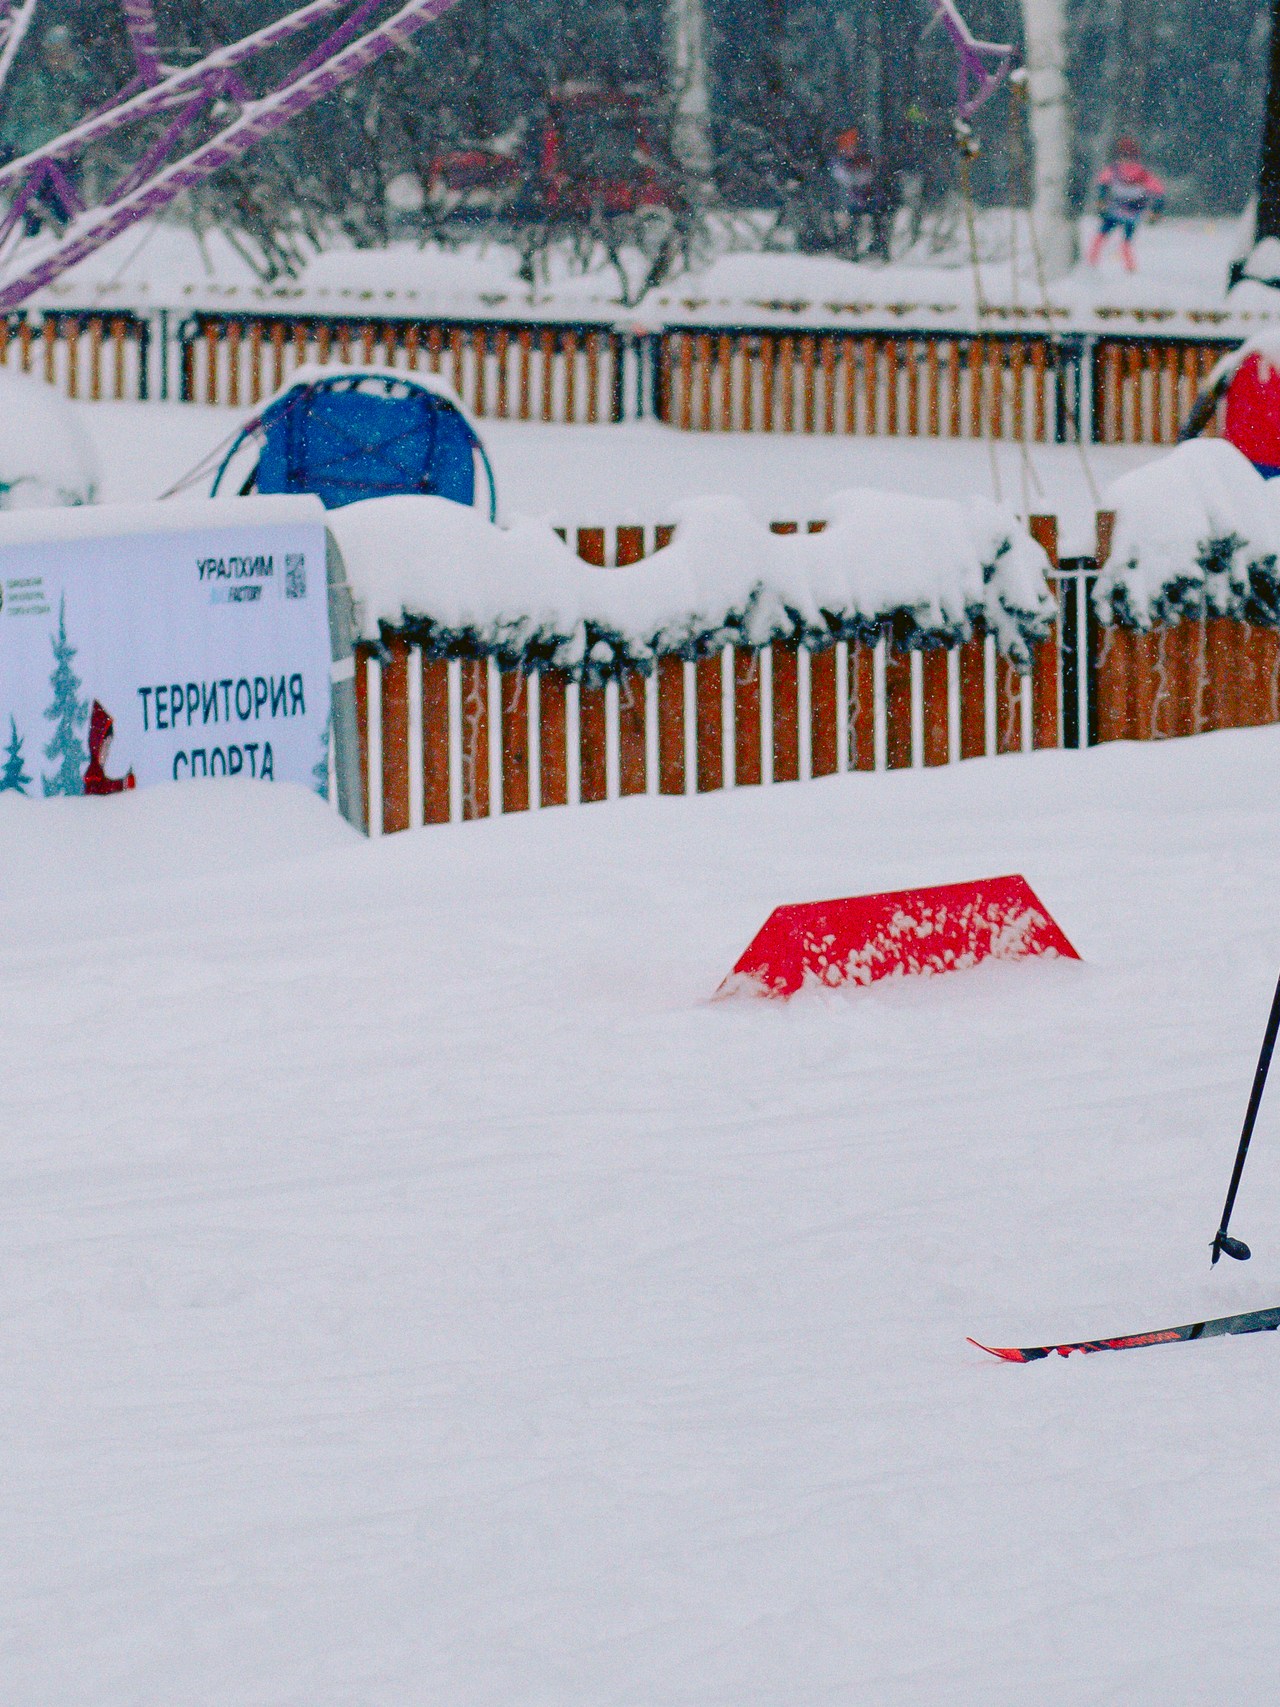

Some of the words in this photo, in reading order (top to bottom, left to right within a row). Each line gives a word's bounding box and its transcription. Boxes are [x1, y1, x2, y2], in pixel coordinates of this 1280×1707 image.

[197, 555, 273, 580] УРАЛХИМ
[138, 673, 306, 731] ТЕРРИТОРИЯ
[172, 741, 274, 781] СПОРТА
